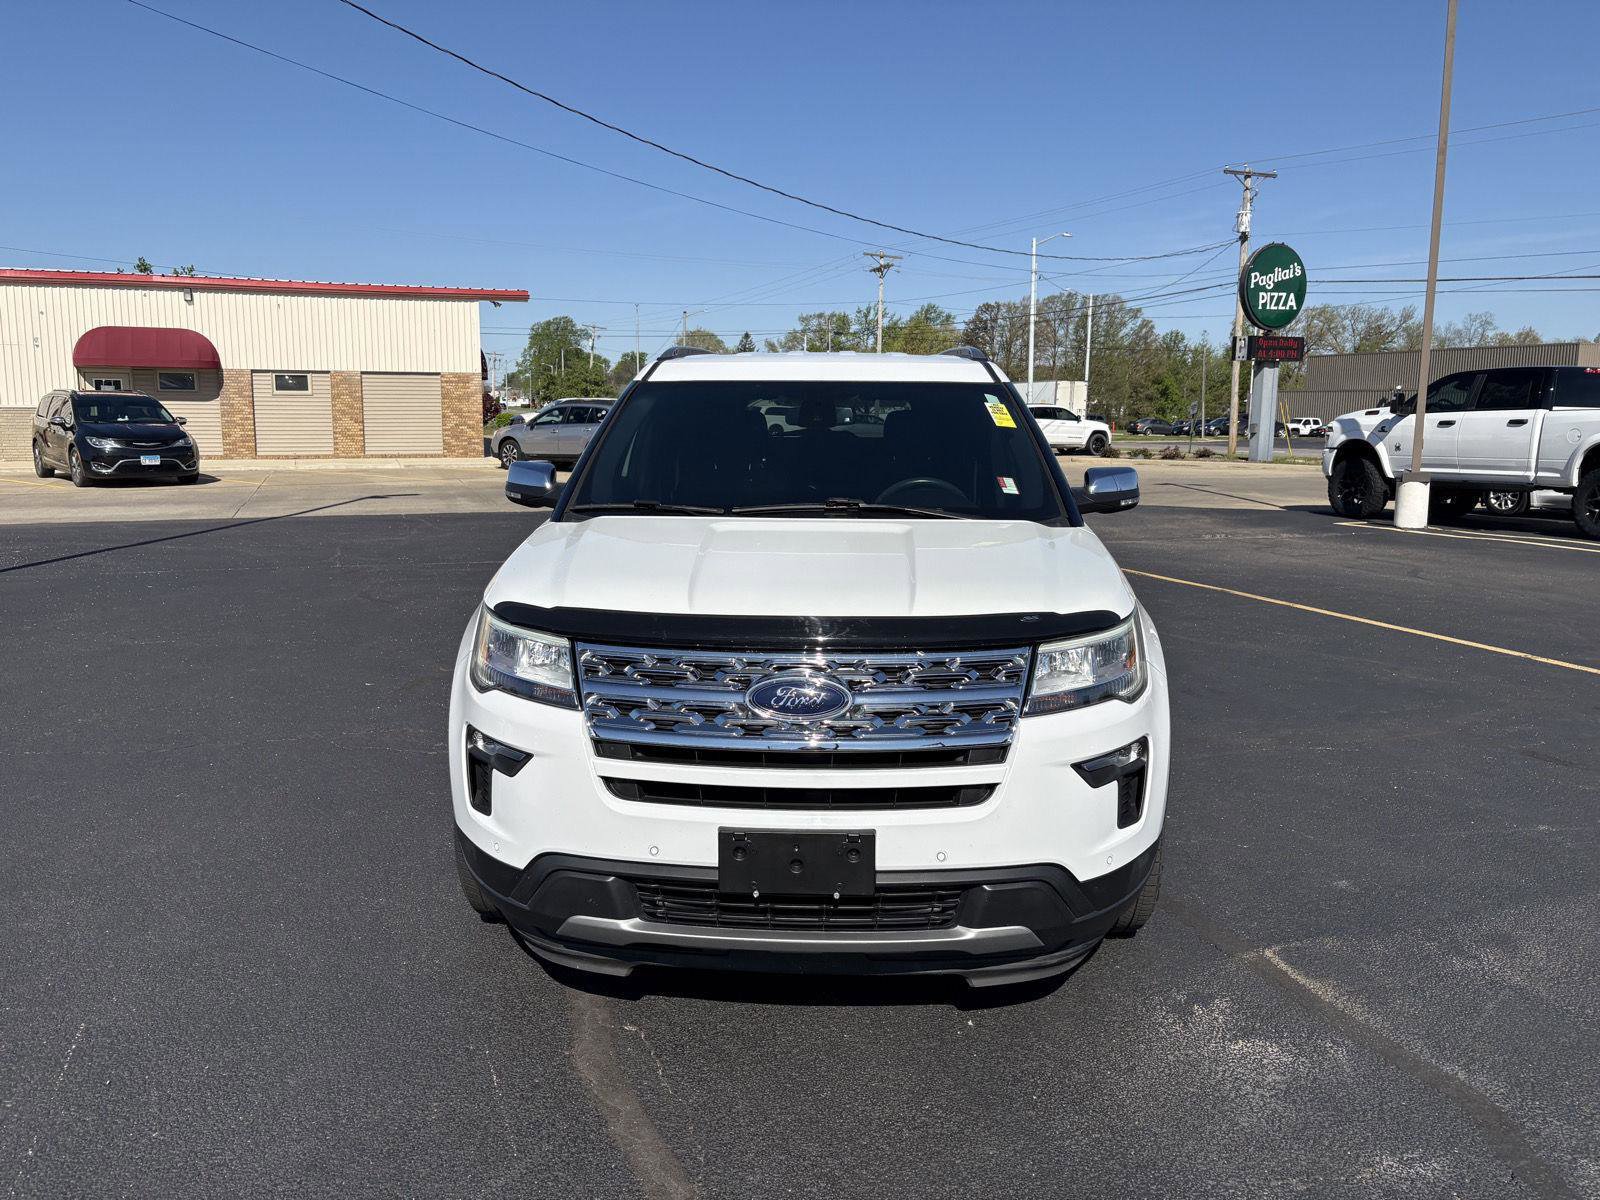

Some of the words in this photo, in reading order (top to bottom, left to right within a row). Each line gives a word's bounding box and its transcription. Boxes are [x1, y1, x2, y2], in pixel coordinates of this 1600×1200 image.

[1250, 262, 1302, 289] Pagliai's
[1258, 292, 1297, 310] PIZZA
[1258, 338, 1278, 348] Open
[1286, 349, 1297, 358] PM
[771, 686, 826, 709] Ford
